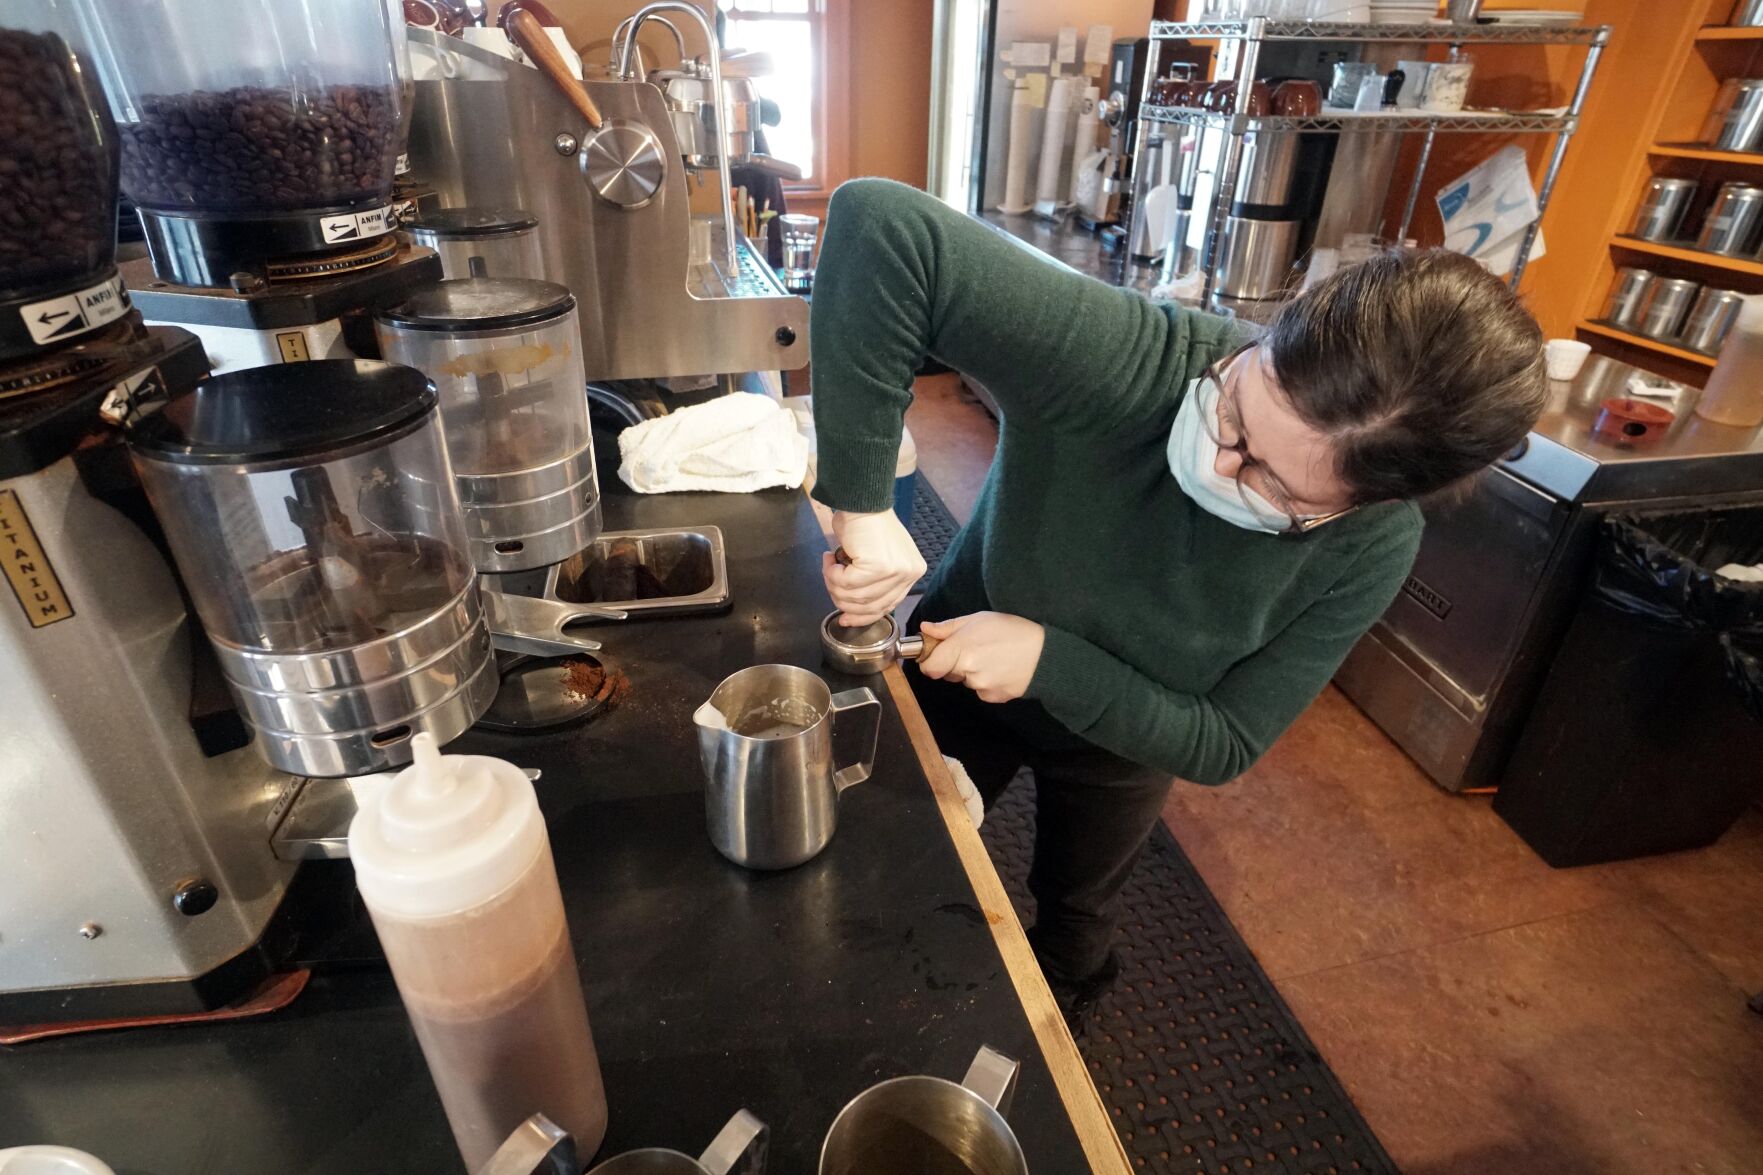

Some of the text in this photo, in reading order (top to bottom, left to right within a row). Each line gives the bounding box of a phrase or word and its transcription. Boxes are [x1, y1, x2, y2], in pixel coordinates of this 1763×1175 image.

[361, 213, 382, 225] ANFIM
[0, 509, 58, 617] ITANIUM
[1408, 578, 1444, 610] BART
